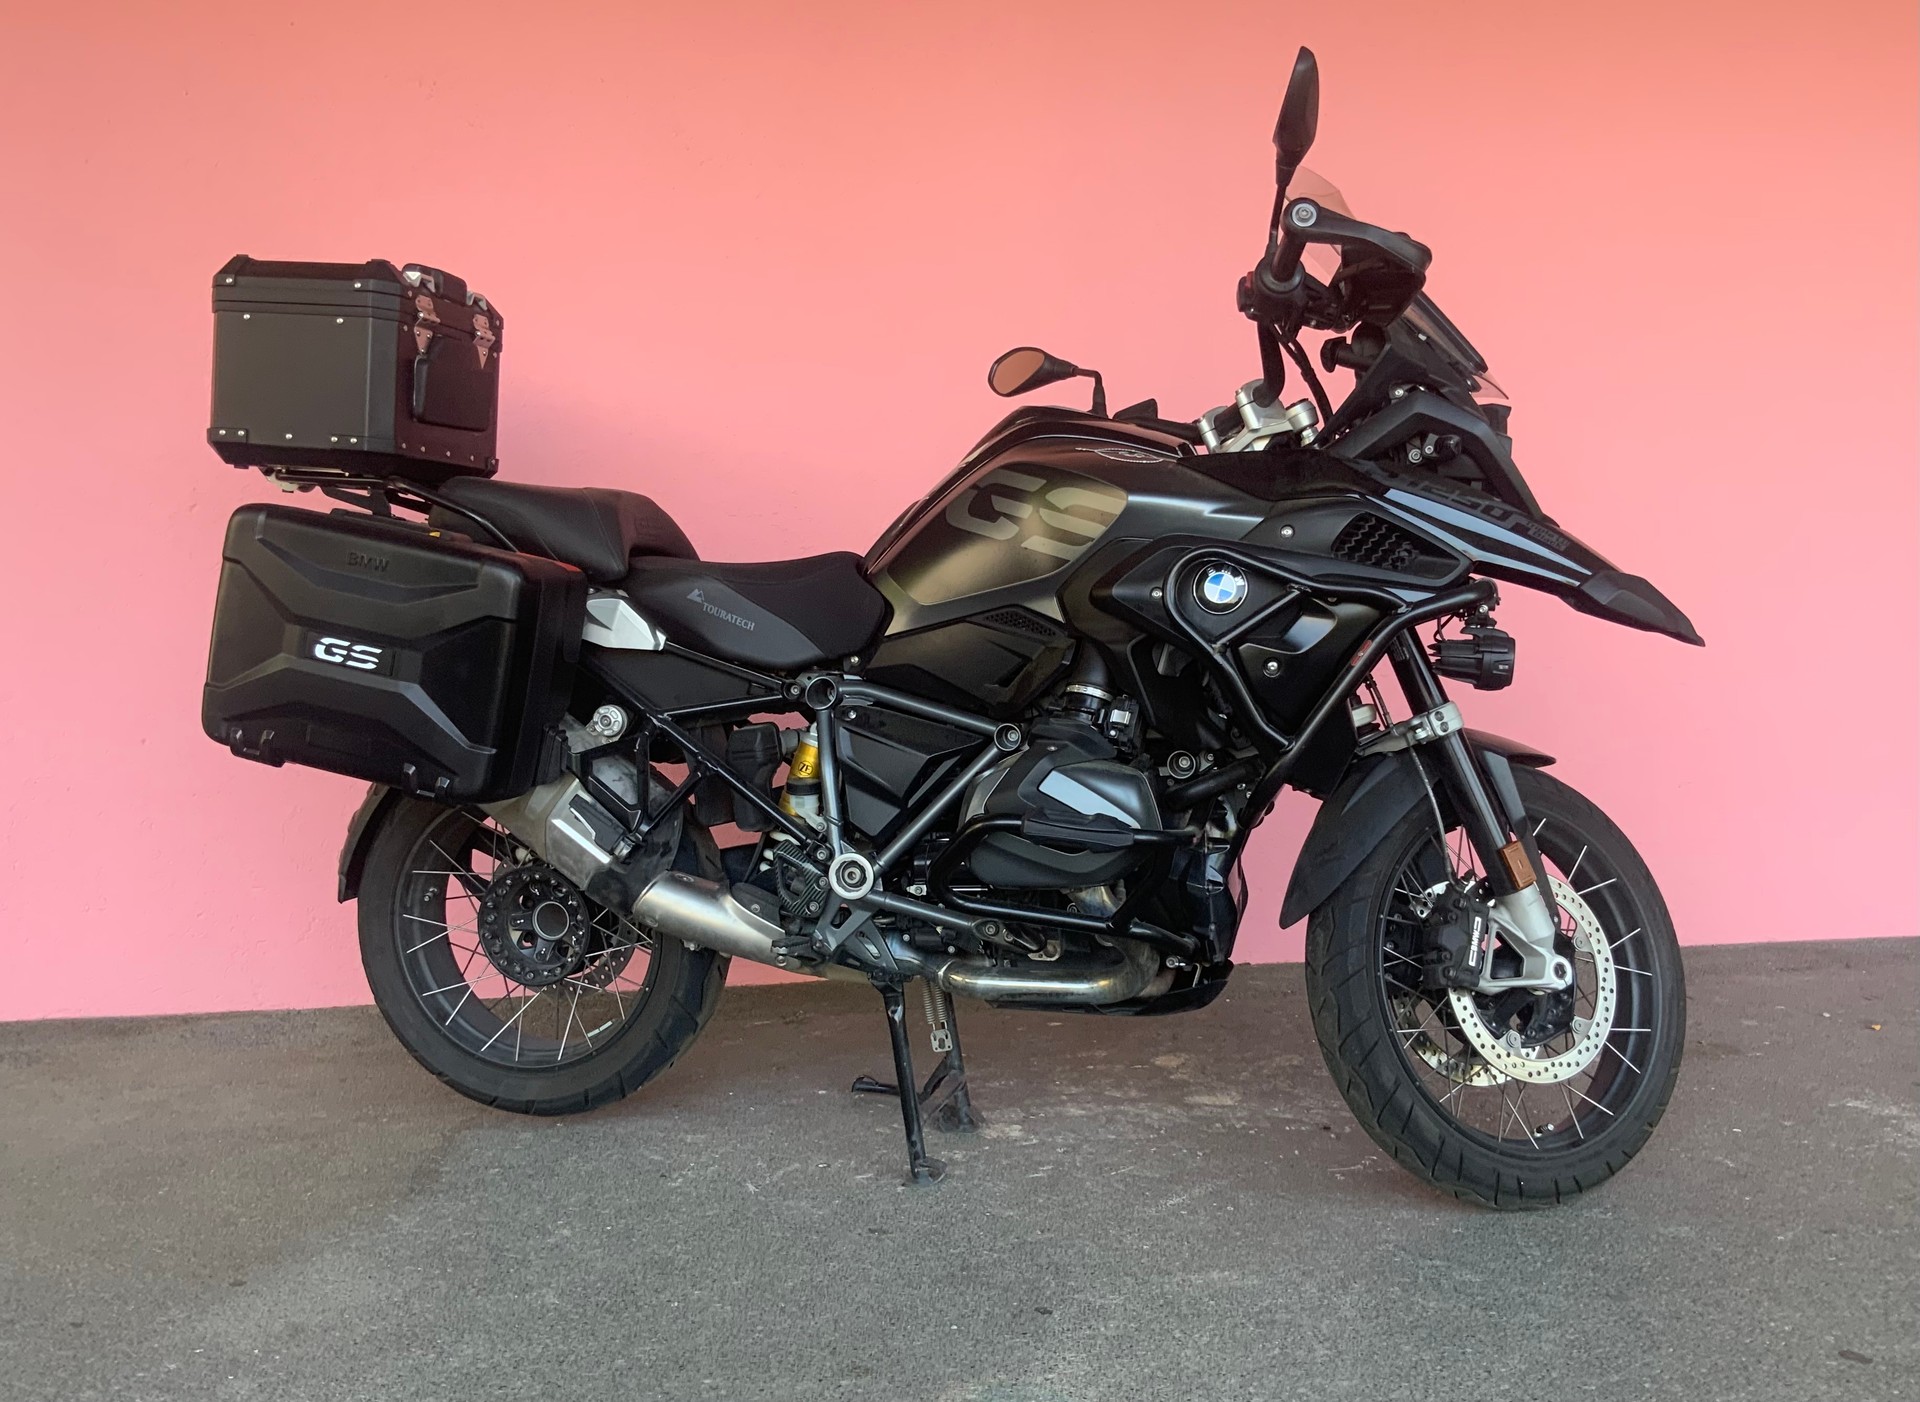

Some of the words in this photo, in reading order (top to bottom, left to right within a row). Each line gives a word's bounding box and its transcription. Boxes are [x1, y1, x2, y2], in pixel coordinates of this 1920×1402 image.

[945, 469, 1126, 561] GS
[348, 552, 389, 573] BMW
[703, 602, 755, 631] TOURATECH
[315, 637, 383, 669] GS
